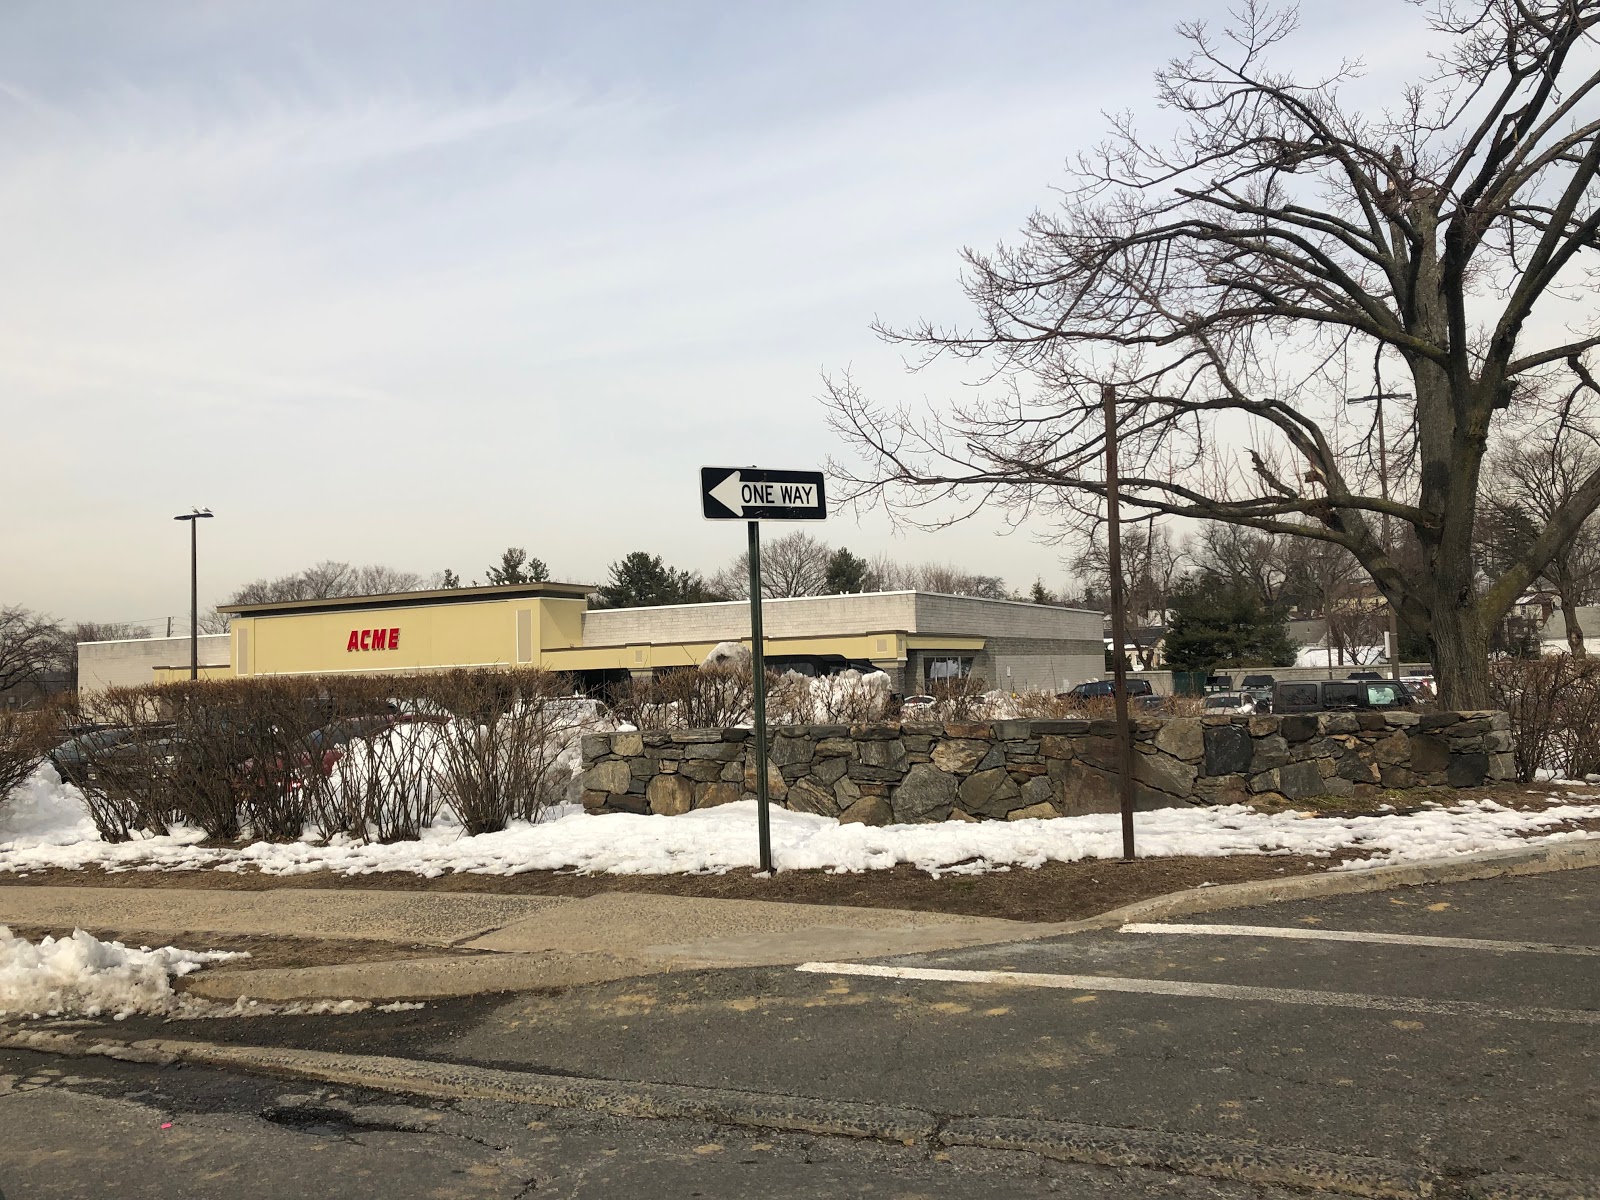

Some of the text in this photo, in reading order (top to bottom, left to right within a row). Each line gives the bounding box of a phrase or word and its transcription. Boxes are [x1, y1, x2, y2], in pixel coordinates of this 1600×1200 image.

[741, 484, 813, 505] ONE WAY
[346, 627, 400, 652] ACME
